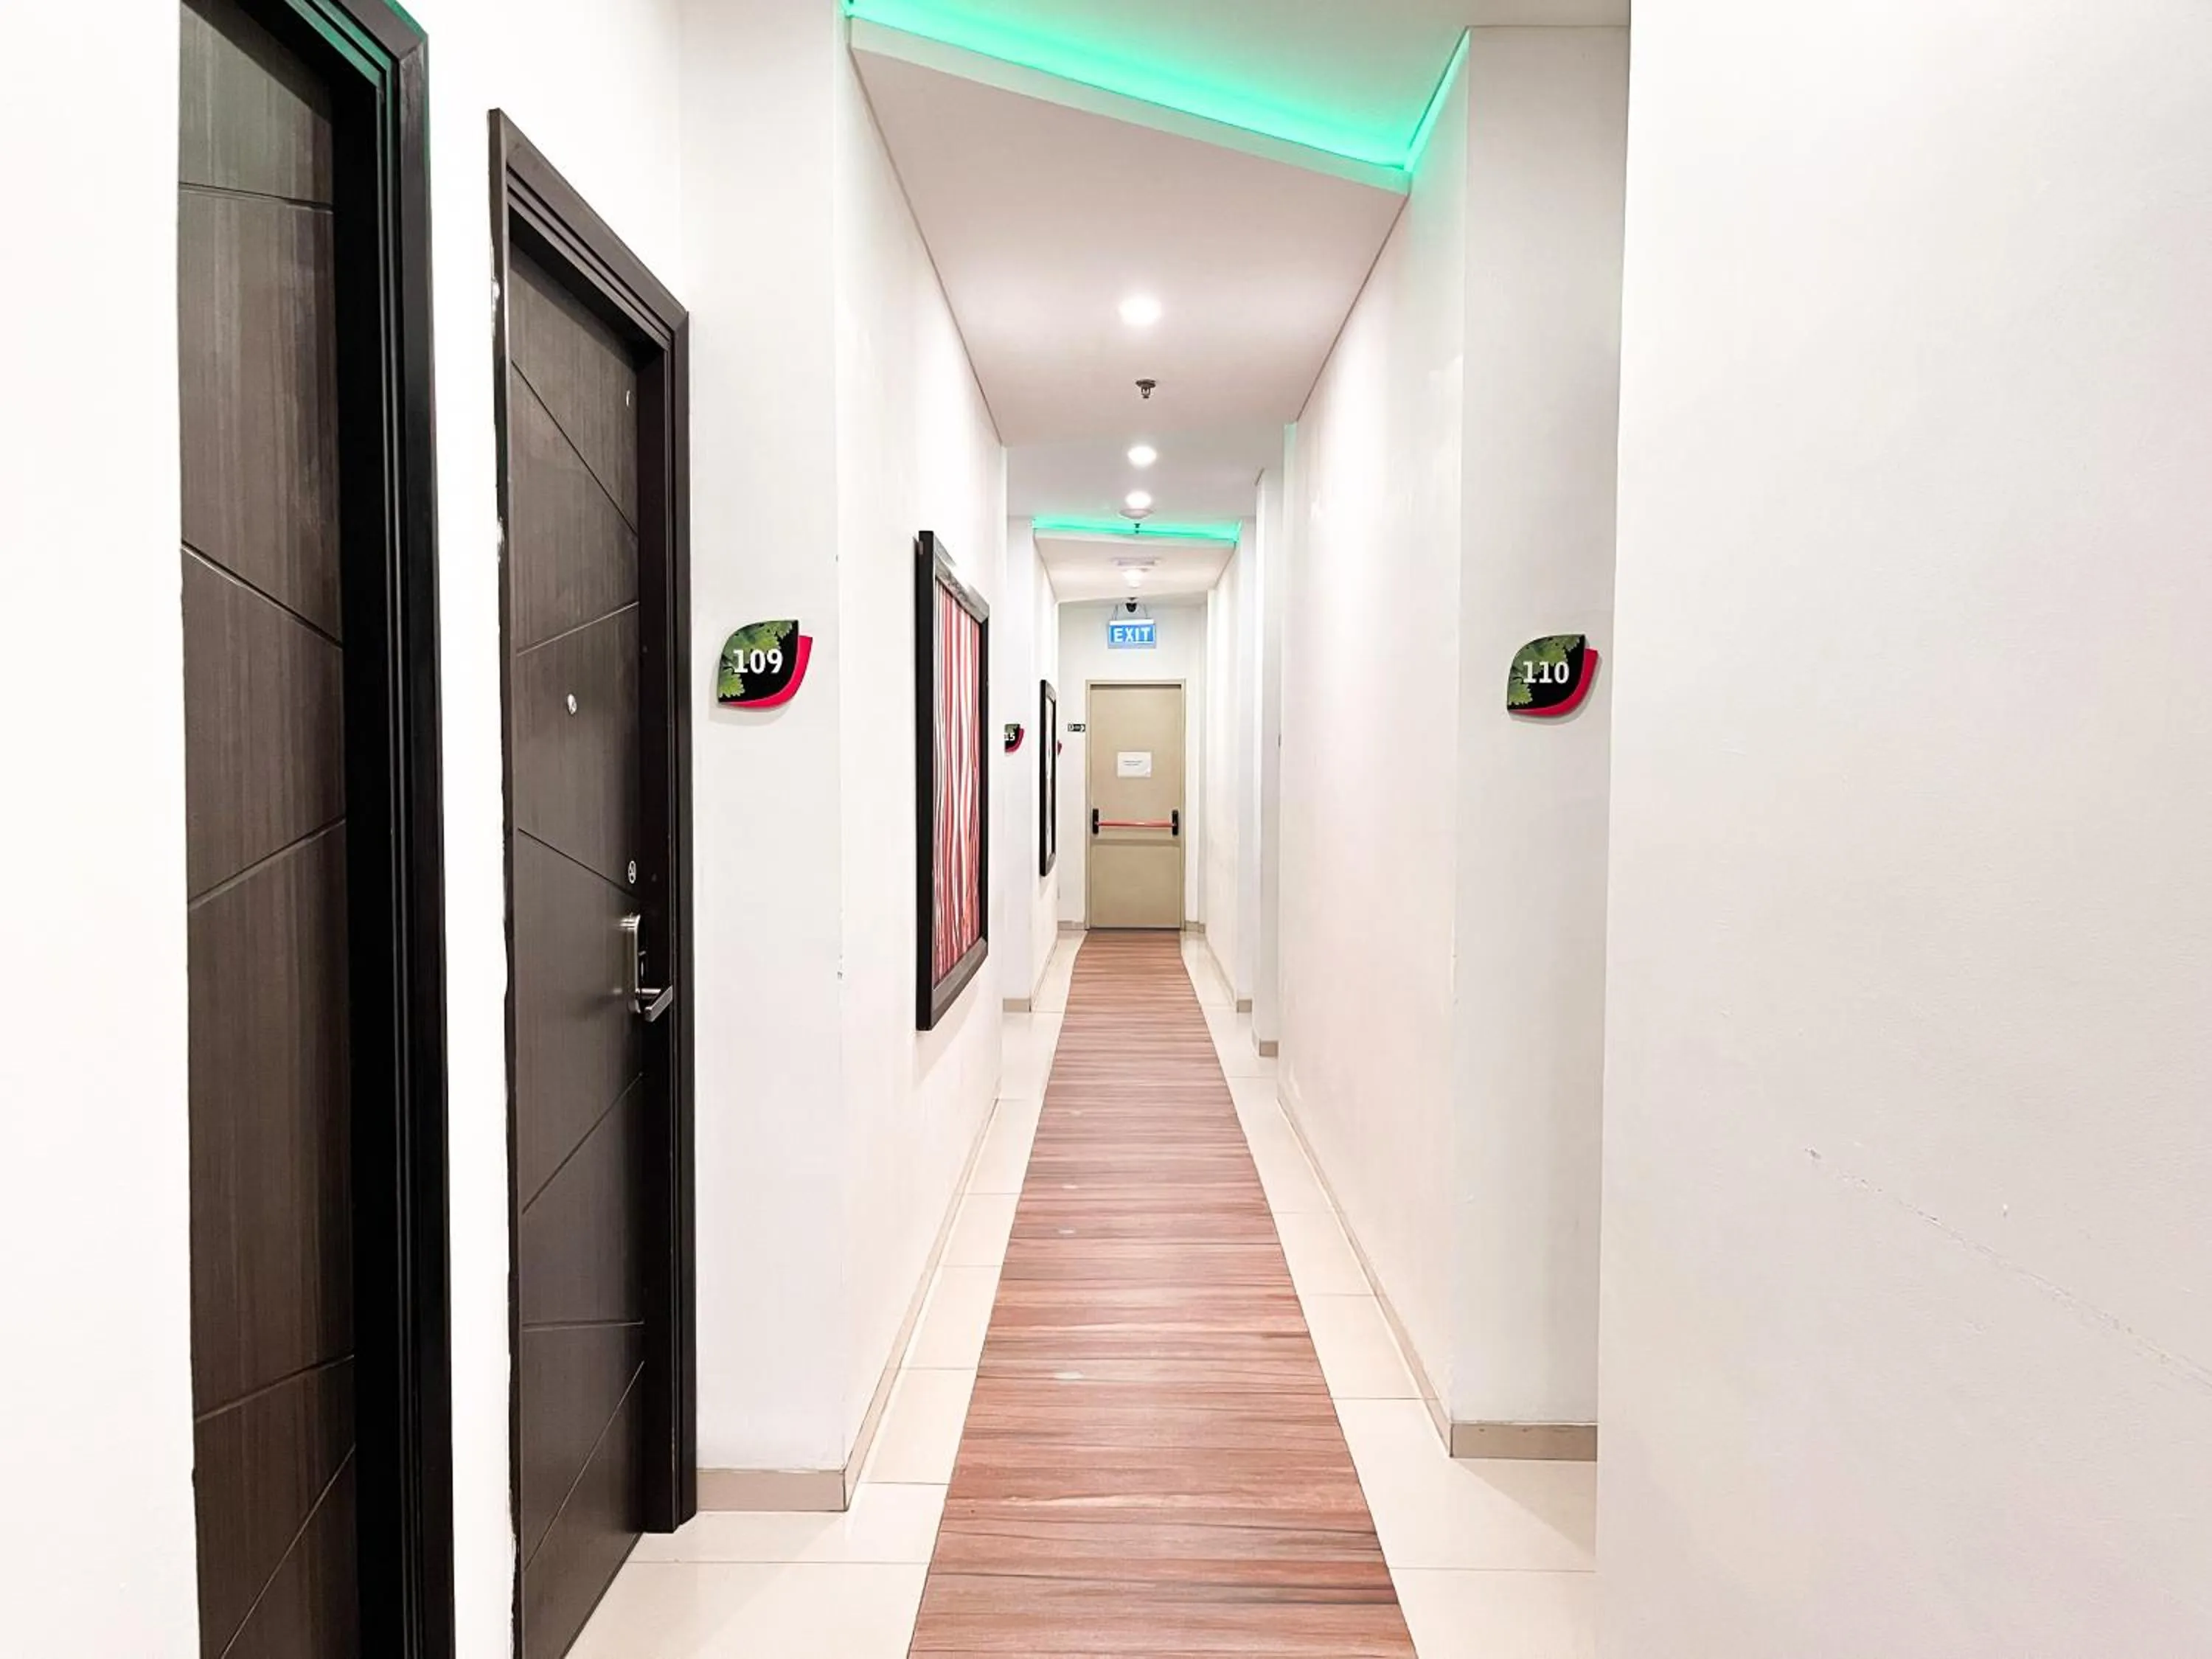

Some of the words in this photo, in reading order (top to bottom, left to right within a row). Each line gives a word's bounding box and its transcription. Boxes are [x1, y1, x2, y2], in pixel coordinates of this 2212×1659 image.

[1113, 627, 1151, 643] EXIT
[732, 648, 784, 675] 109
[1522, 660, 1570, 684] 110
